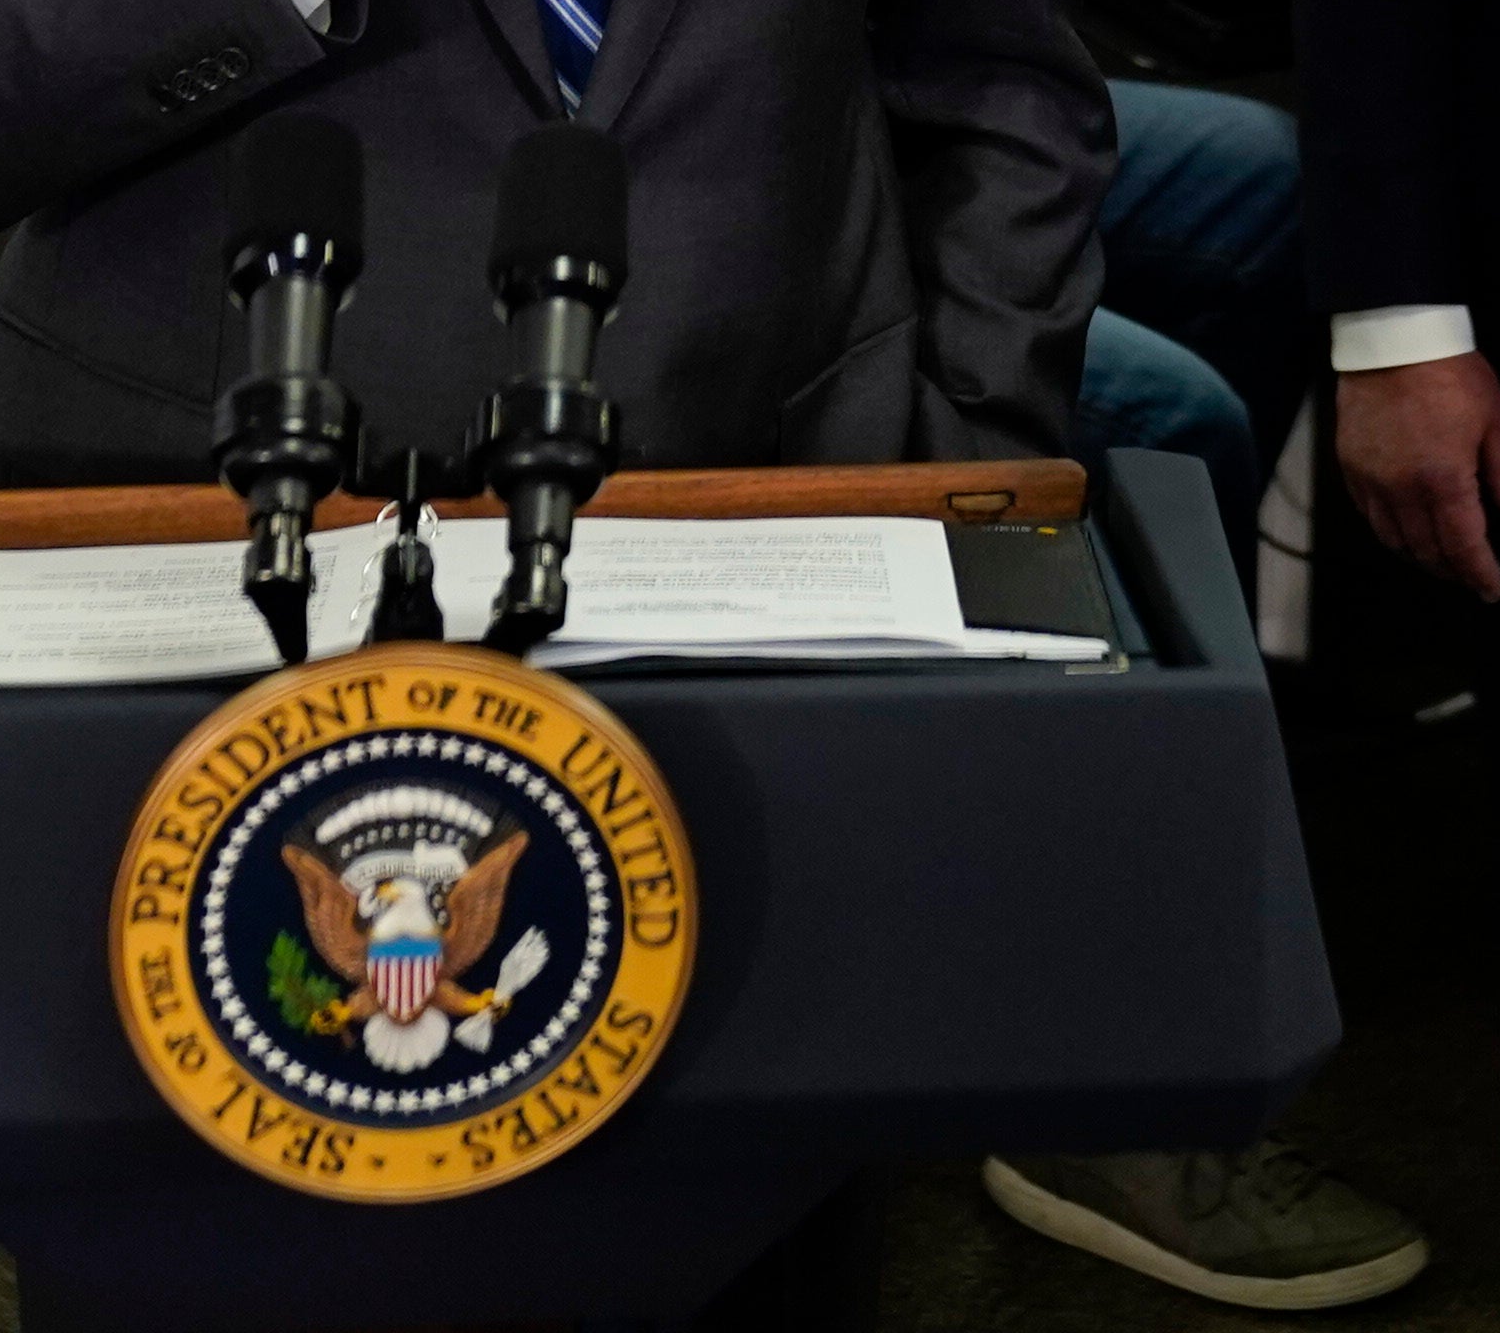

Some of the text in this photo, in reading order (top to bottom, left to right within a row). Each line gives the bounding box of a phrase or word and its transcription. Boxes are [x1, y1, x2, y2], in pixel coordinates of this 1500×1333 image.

[132, 674, 680, 1175] SEAL OF THE PRESIDENT OF THE UNITED STATES
